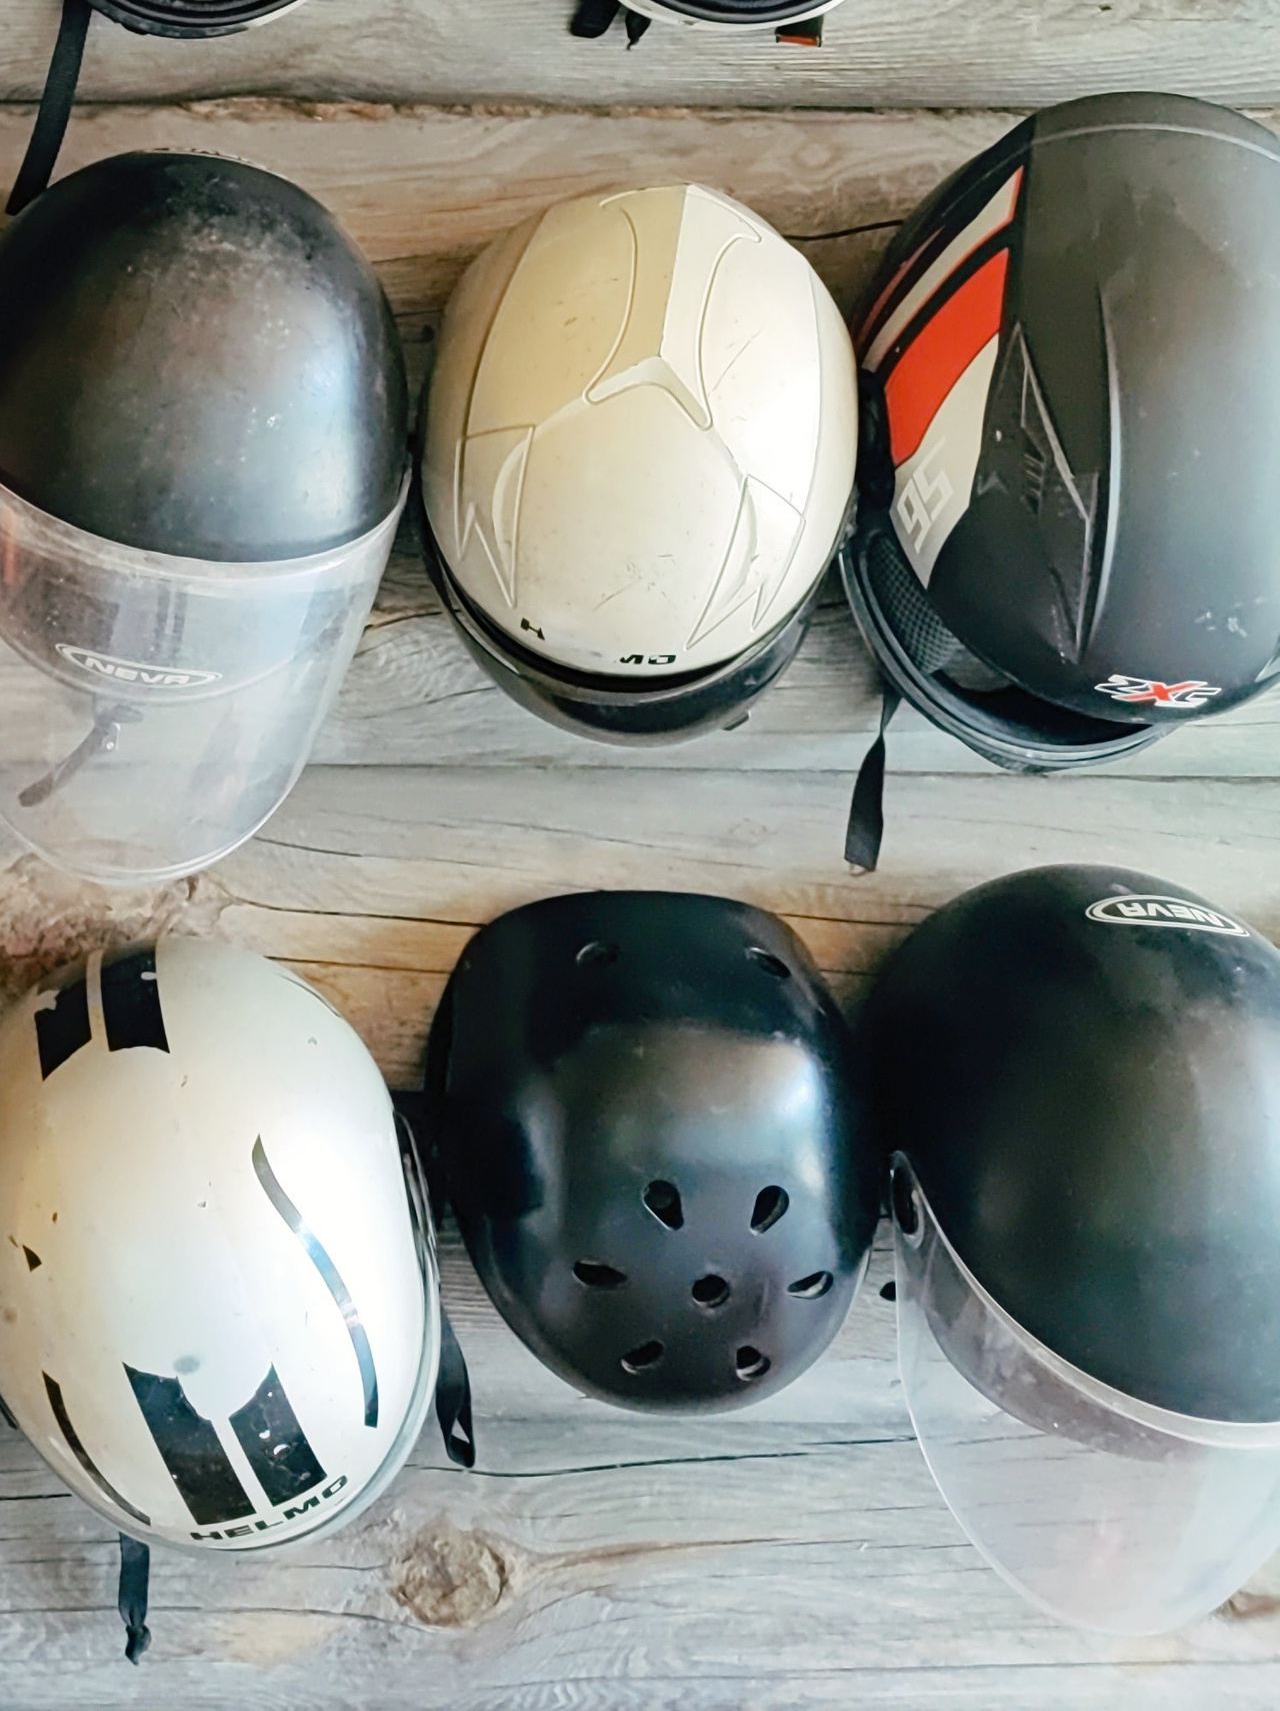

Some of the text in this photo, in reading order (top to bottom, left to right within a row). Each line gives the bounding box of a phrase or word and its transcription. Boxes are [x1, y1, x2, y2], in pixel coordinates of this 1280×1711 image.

[84, 656, 190, 685] NEVA
[1116, 902, 1225, 928] NEVA
[190, 1474, 348, 1541] HELMO
